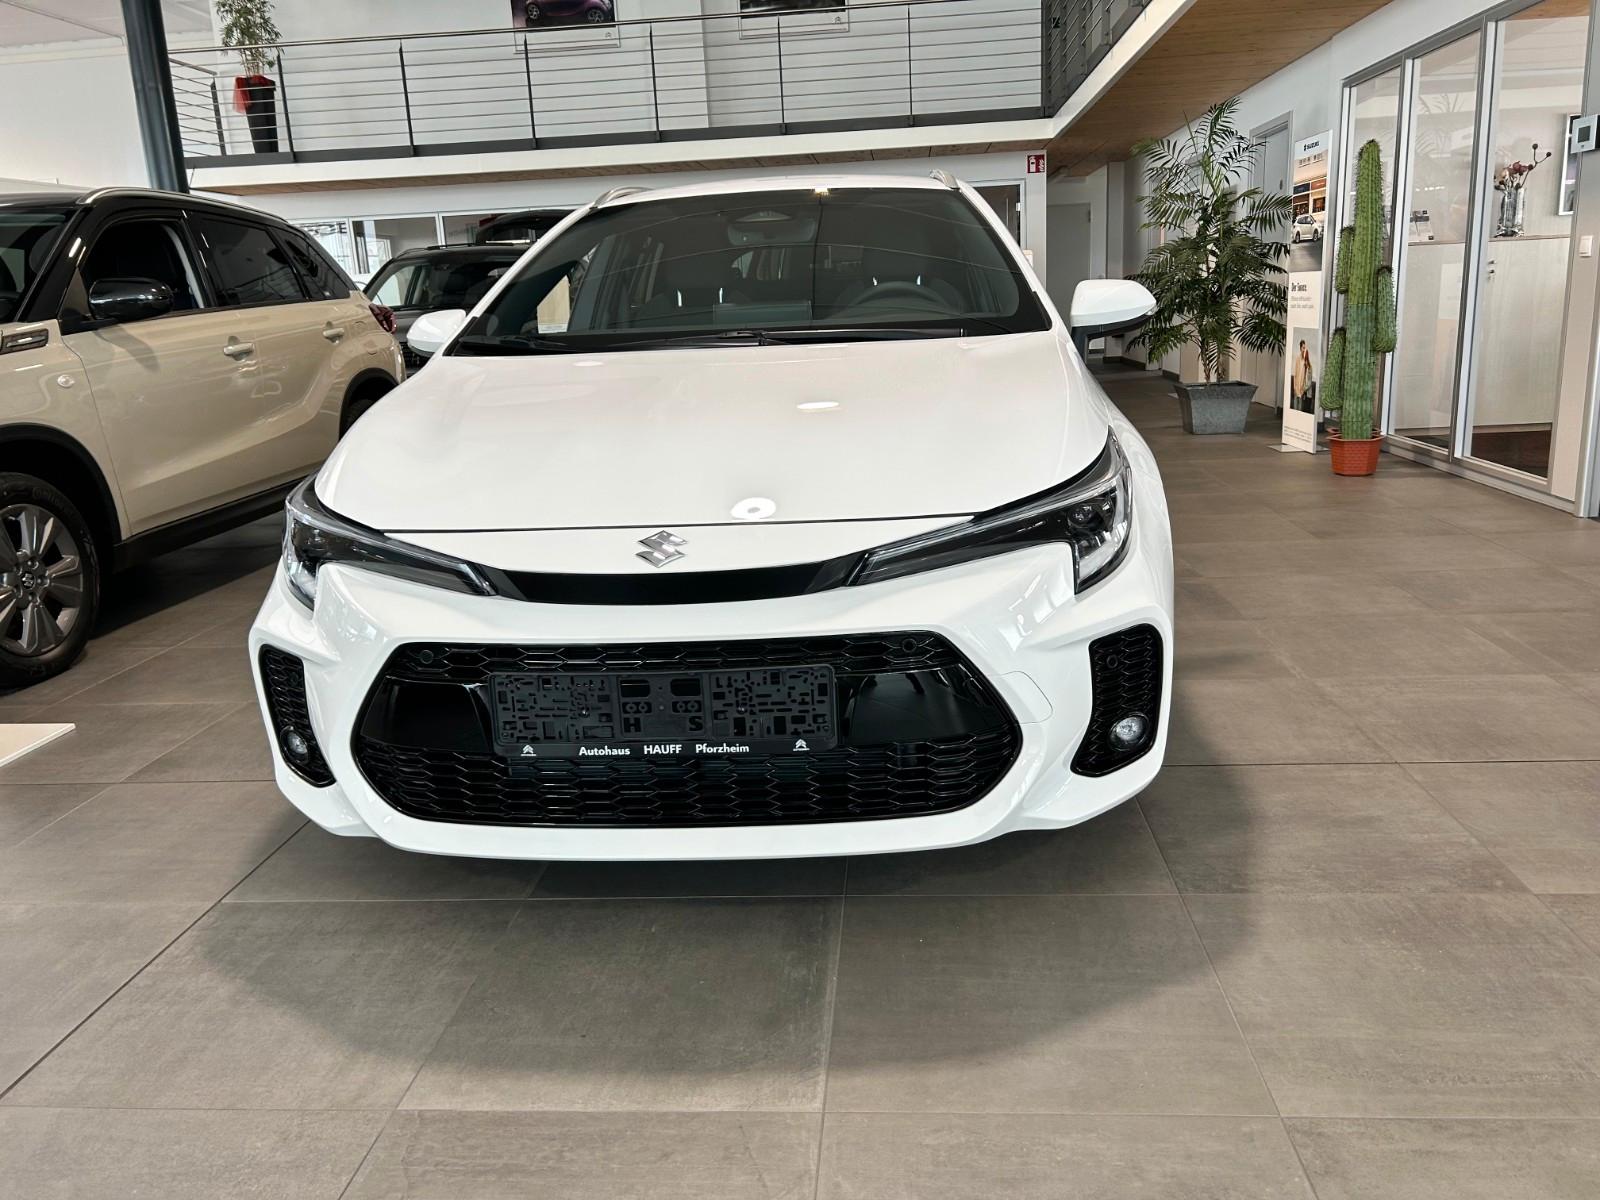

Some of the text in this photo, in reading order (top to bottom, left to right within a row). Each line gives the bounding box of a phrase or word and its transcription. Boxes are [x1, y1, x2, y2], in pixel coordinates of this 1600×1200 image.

[579, 743, 750, 756] Autohaus HAUFF Pforzheim
